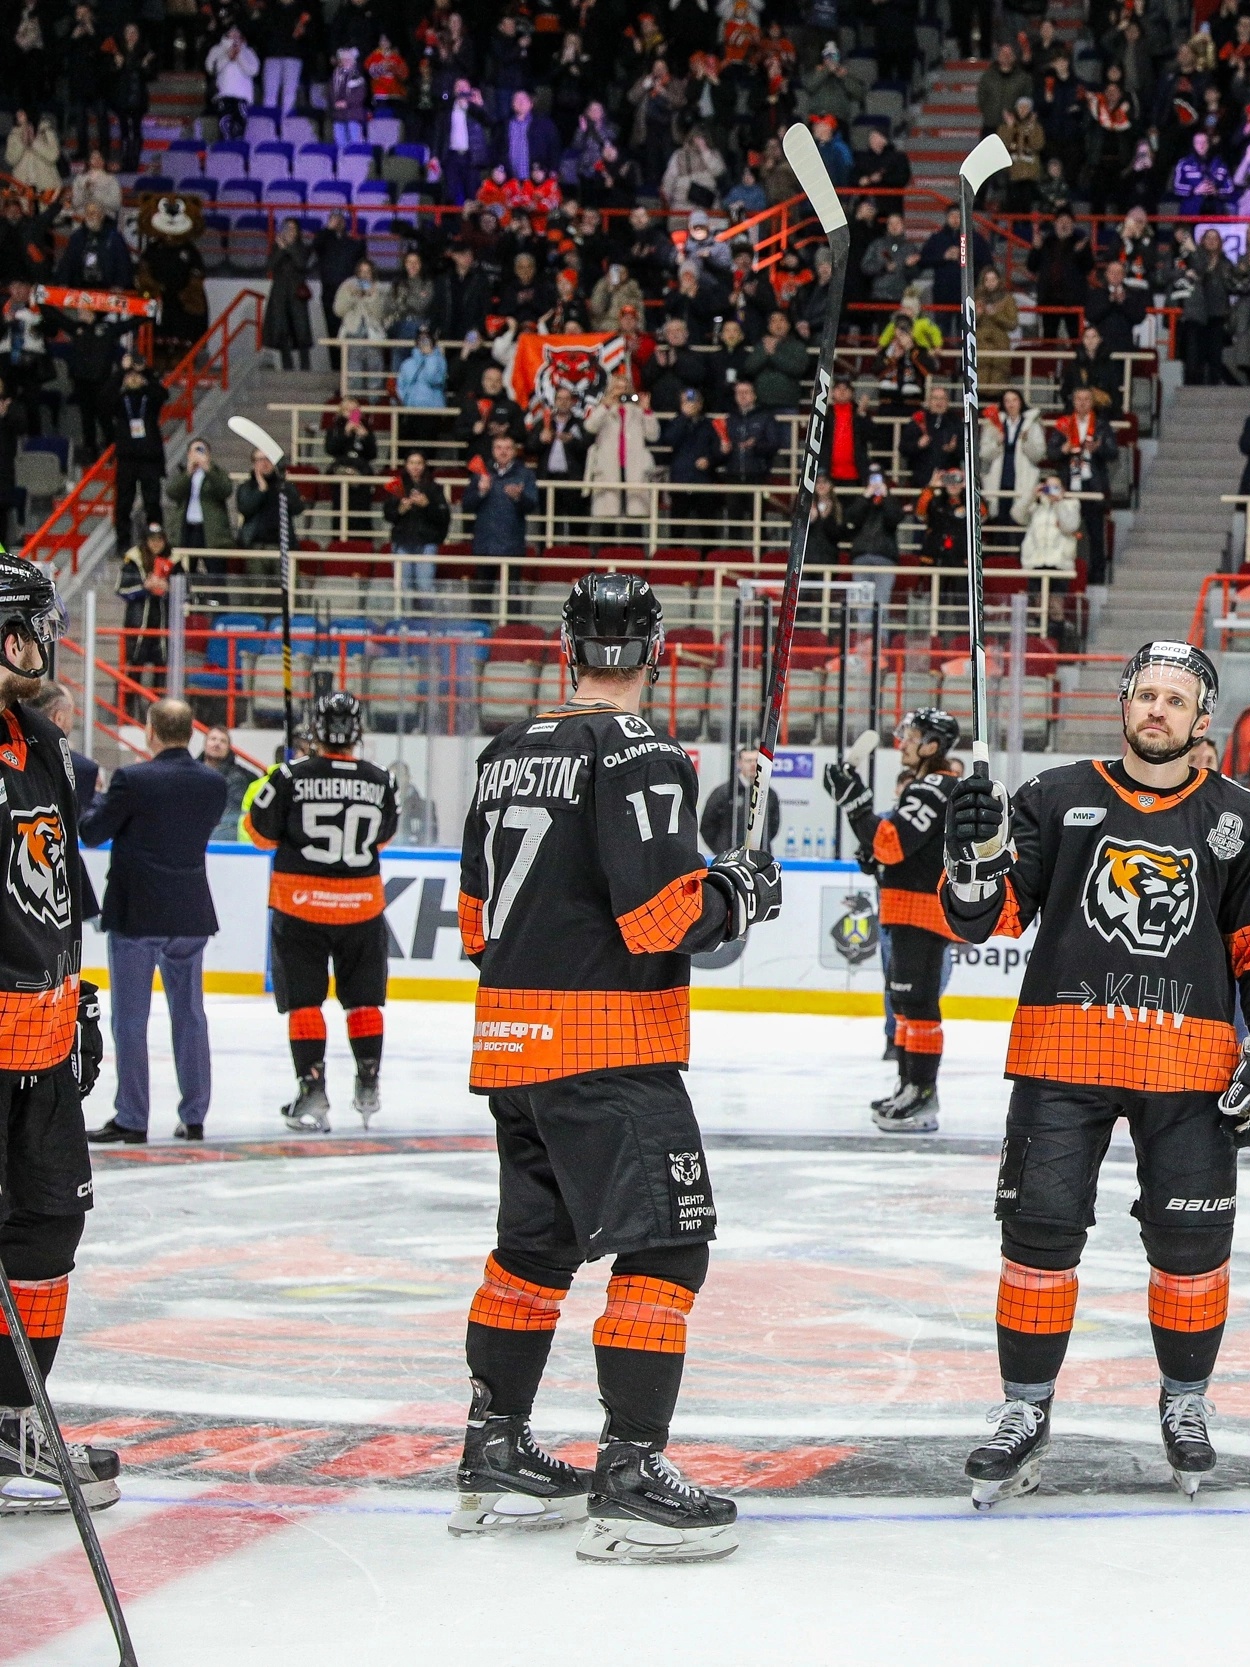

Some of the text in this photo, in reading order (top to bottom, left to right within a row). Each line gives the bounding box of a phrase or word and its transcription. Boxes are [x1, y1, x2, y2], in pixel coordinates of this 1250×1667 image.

[966, 296, 978, 410] CCM
[803, 368, 831, 494] CCM
[604, 646, 622, 666] 17
[1153, 645, 1188, 656] согаз
[603, 742, 687, 768] OLIMPBET
[477, 756, 580, 803] KAPUSTIN
[626, 783, 684, 842] 17
[747, 764, 763, 831] CCM
[898, 796, 938, 833] 25
[1073, 812, 1095, 820] МИР
[301, 802, 382, 867] 50
[483, 806, 553, 941] 17
[1105, 973, 1193, 1029] KHV
[484, 1041, 524, 1052] ВОСТОК
[678, 1195, 705, 1206] ЦЕНТР
[679, 1219, 702, 1231] ТИГР
[518, 1468, 551, 1483] BAUER
[644, 1491, 680, 1508] BAUER
